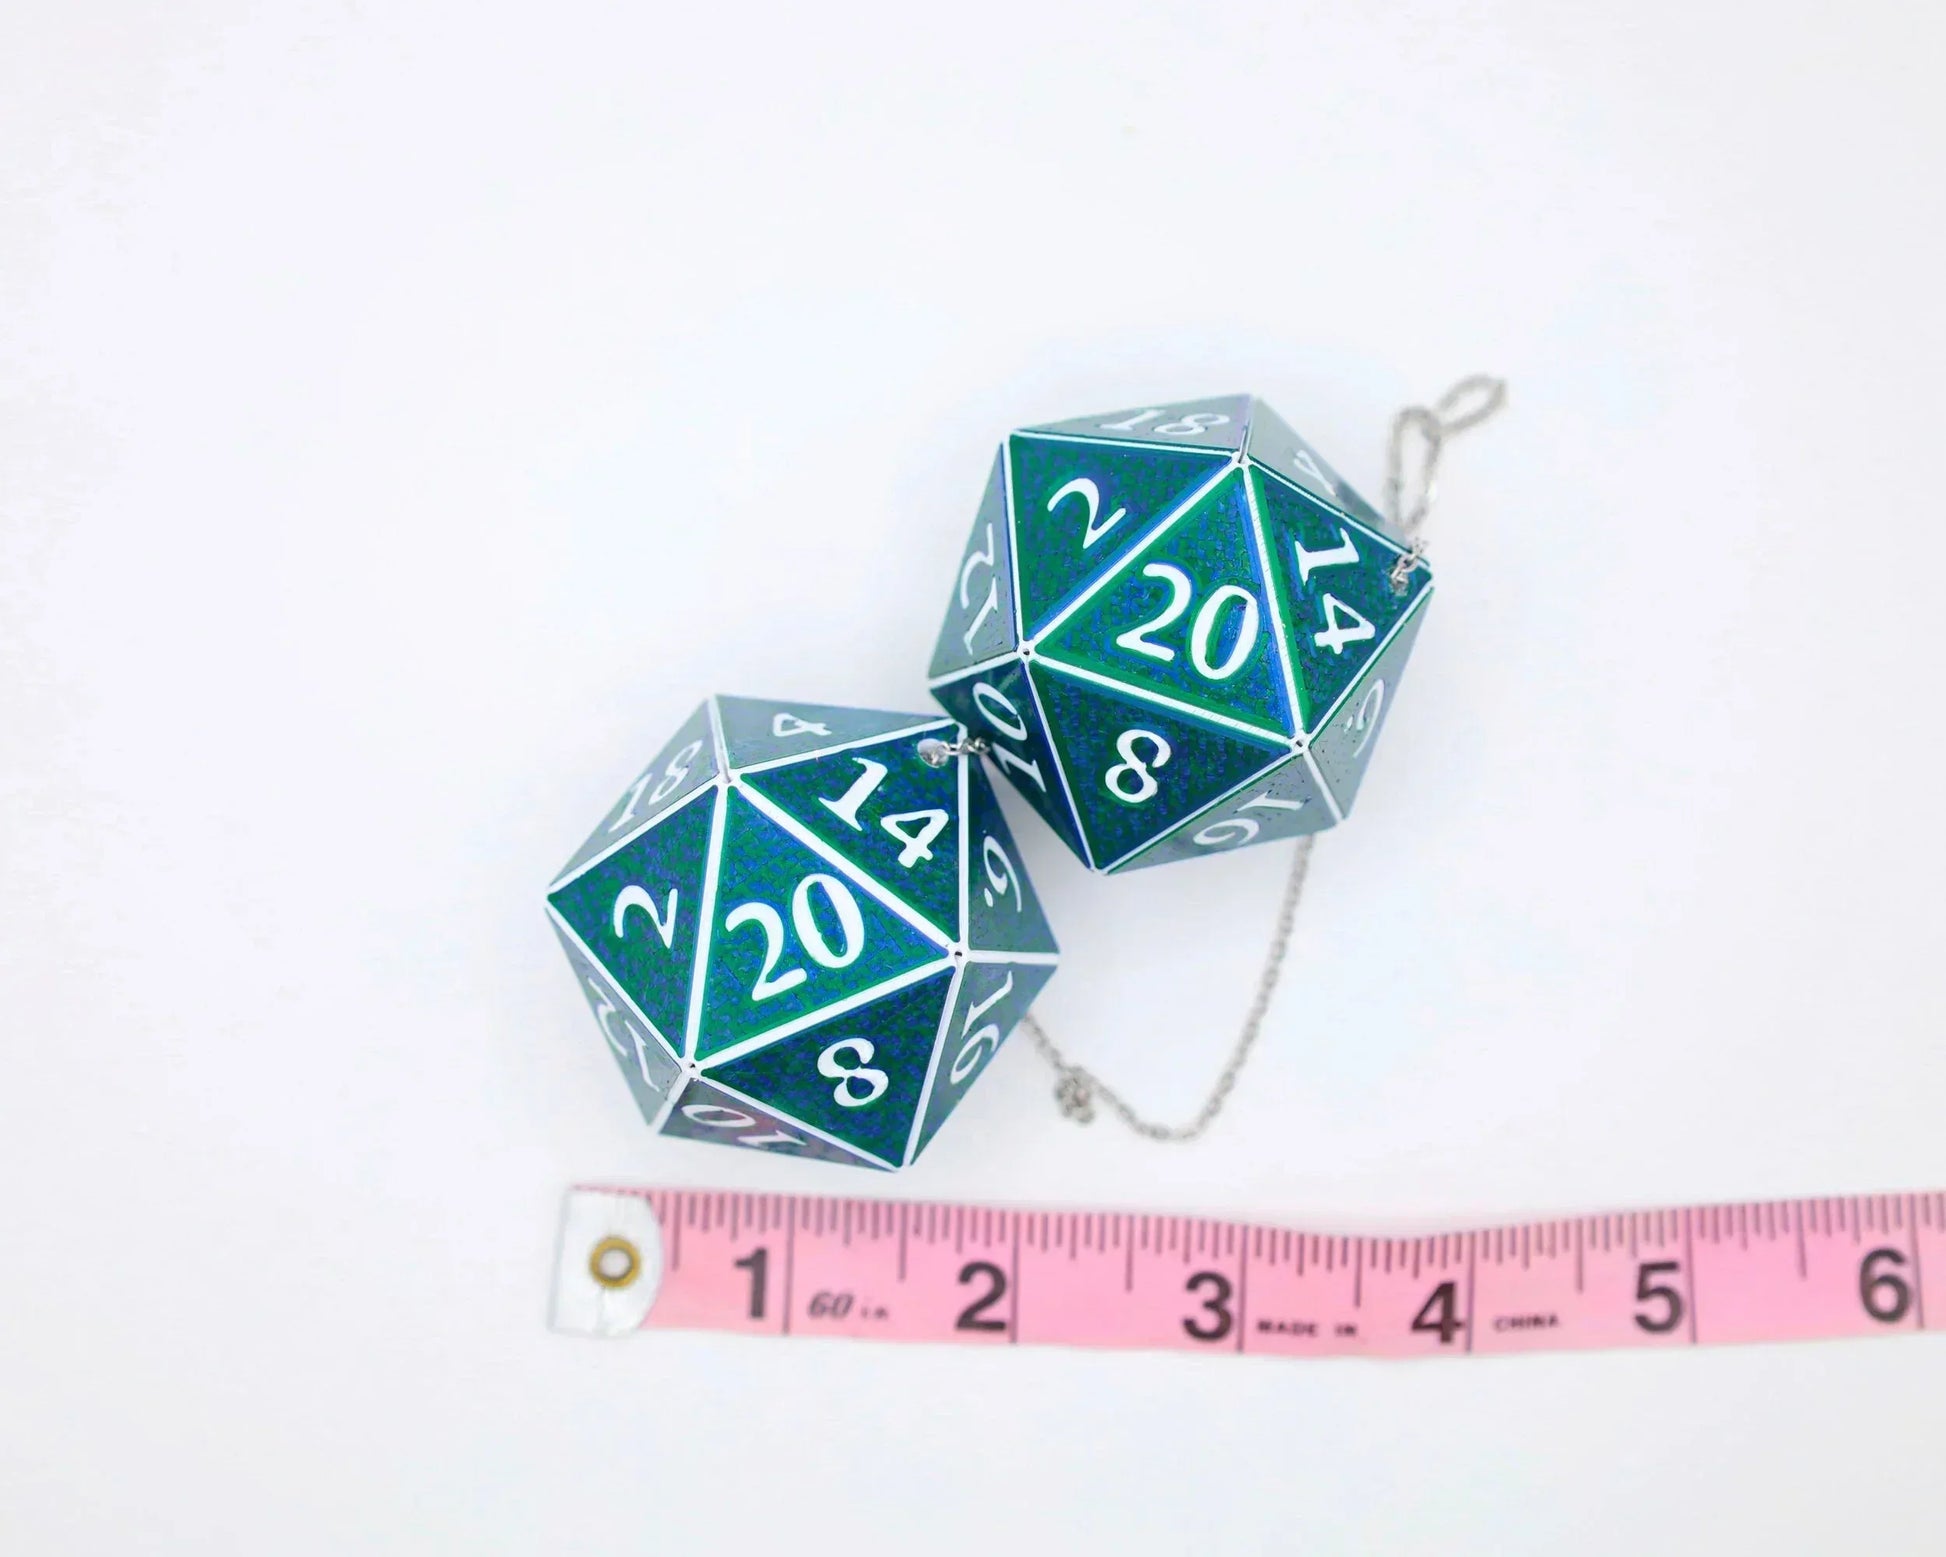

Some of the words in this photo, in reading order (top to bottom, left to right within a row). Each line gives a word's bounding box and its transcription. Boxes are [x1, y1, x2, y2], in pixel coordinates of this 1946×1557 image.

[1099, 408, 1230, 436] 18
[1047, 478, 1127, 549] 2
[960, 523, 998, 654] 12
[1116, 562, 1260, 680] 20
[1294, 527, 1376, 654] 14
[772, 713, 832, 737] 4
[972, 681, 1045, 792] 10
[608, 739, 703, 833] 18
[1105, 729, 1172, 803] 8
[818, 757, 949, 869] 14
[612, 884, 679, 949] 2
[725, 872, 866, 1001] 20
[950, 970, 1015, 1085] 16
[816, 1038, 889, 1107] 8
[681, 1104, 807, 1146] 10
[734, 1248, 768, 1319] 1
[807, 1292, 854, 1320] 60
[953, 1262, 1008, 1332] 2
[1181, 1272, 1233, 1342] 3
[1410, 1281, 1464, 1344] 4
[1633, 1261, 1684, 1333] 5
[1858, 1248, 1911, 1322] 6
[1257, 1318, 1319, 1337] MADE
[1335, 1322, 1358, 1337] IN
[1493, 1314, 1559, 1332] CHINA
